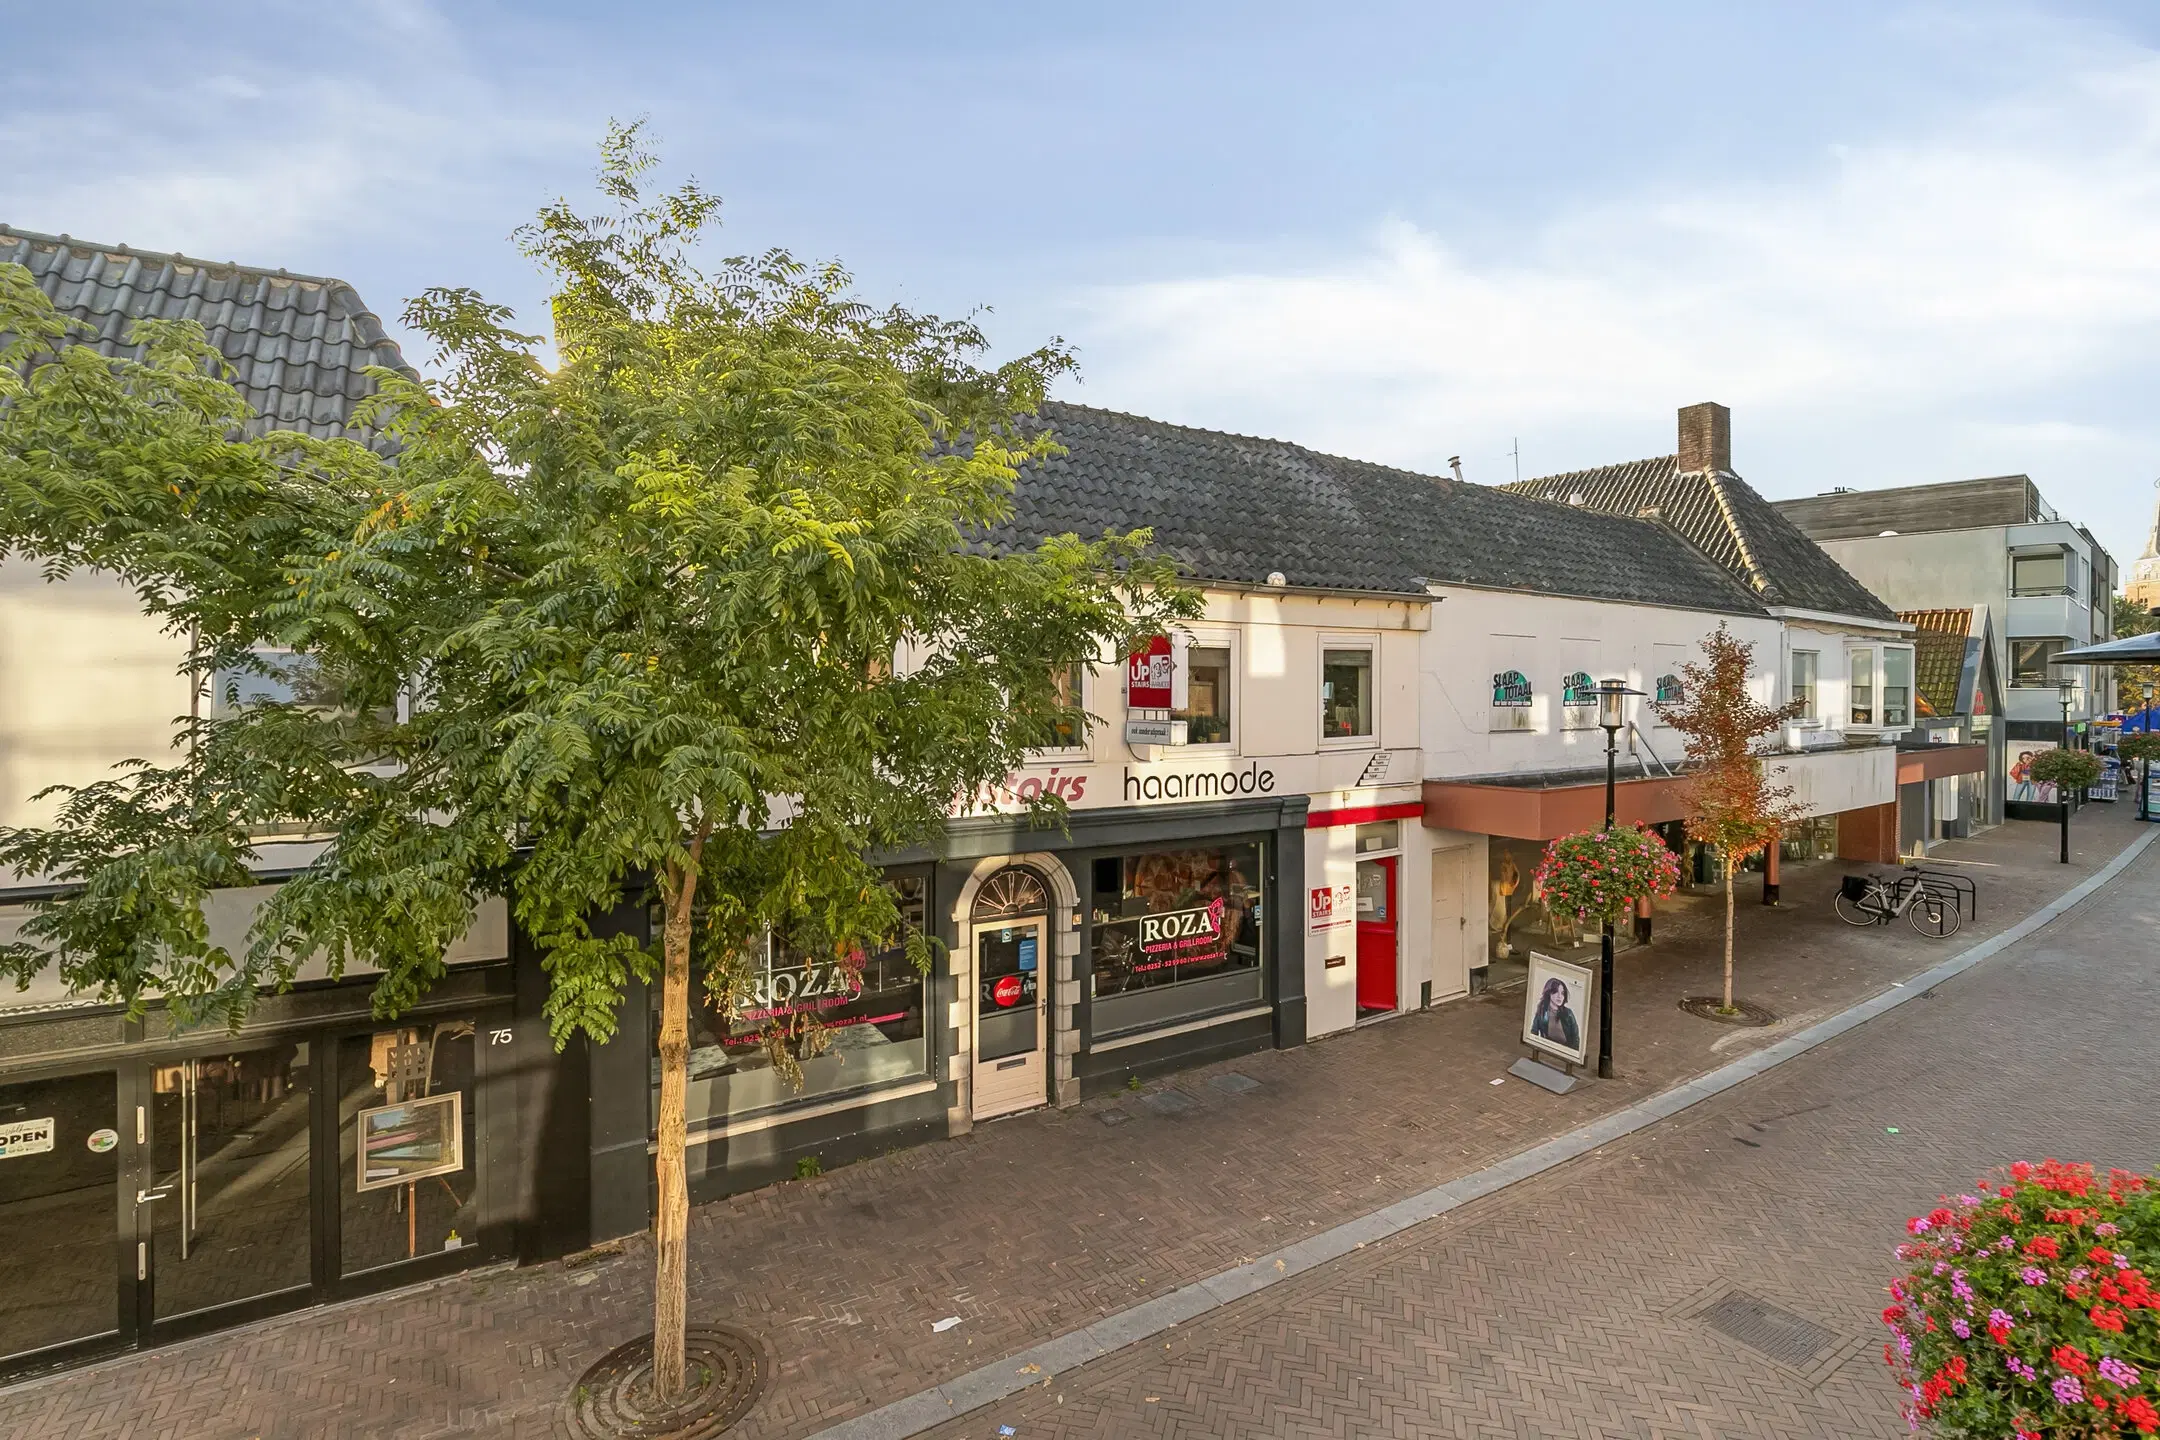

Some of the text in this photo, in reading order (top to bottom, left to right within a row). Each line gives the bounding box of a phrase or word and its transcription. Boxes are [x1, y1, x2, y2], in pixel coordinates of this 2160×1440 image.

[1131, 660, 1149, 681] UP
[1493, 672, 1519, 688] SLAAP
[1563, 673, 1586, 689] SLAAP
[1504, 681, 1533, 700] TOTAAL
[1123, 761, 1275, 801] haarmode
[1312, 890, 1331, 911] UP
[1144, 911, 1214, 942] ROZA
[1145, 942, 1172, 954] PIZZERIA
[489, 1028, 513, 1046] 75
[0, 1130, 48, 1147] OPEN
